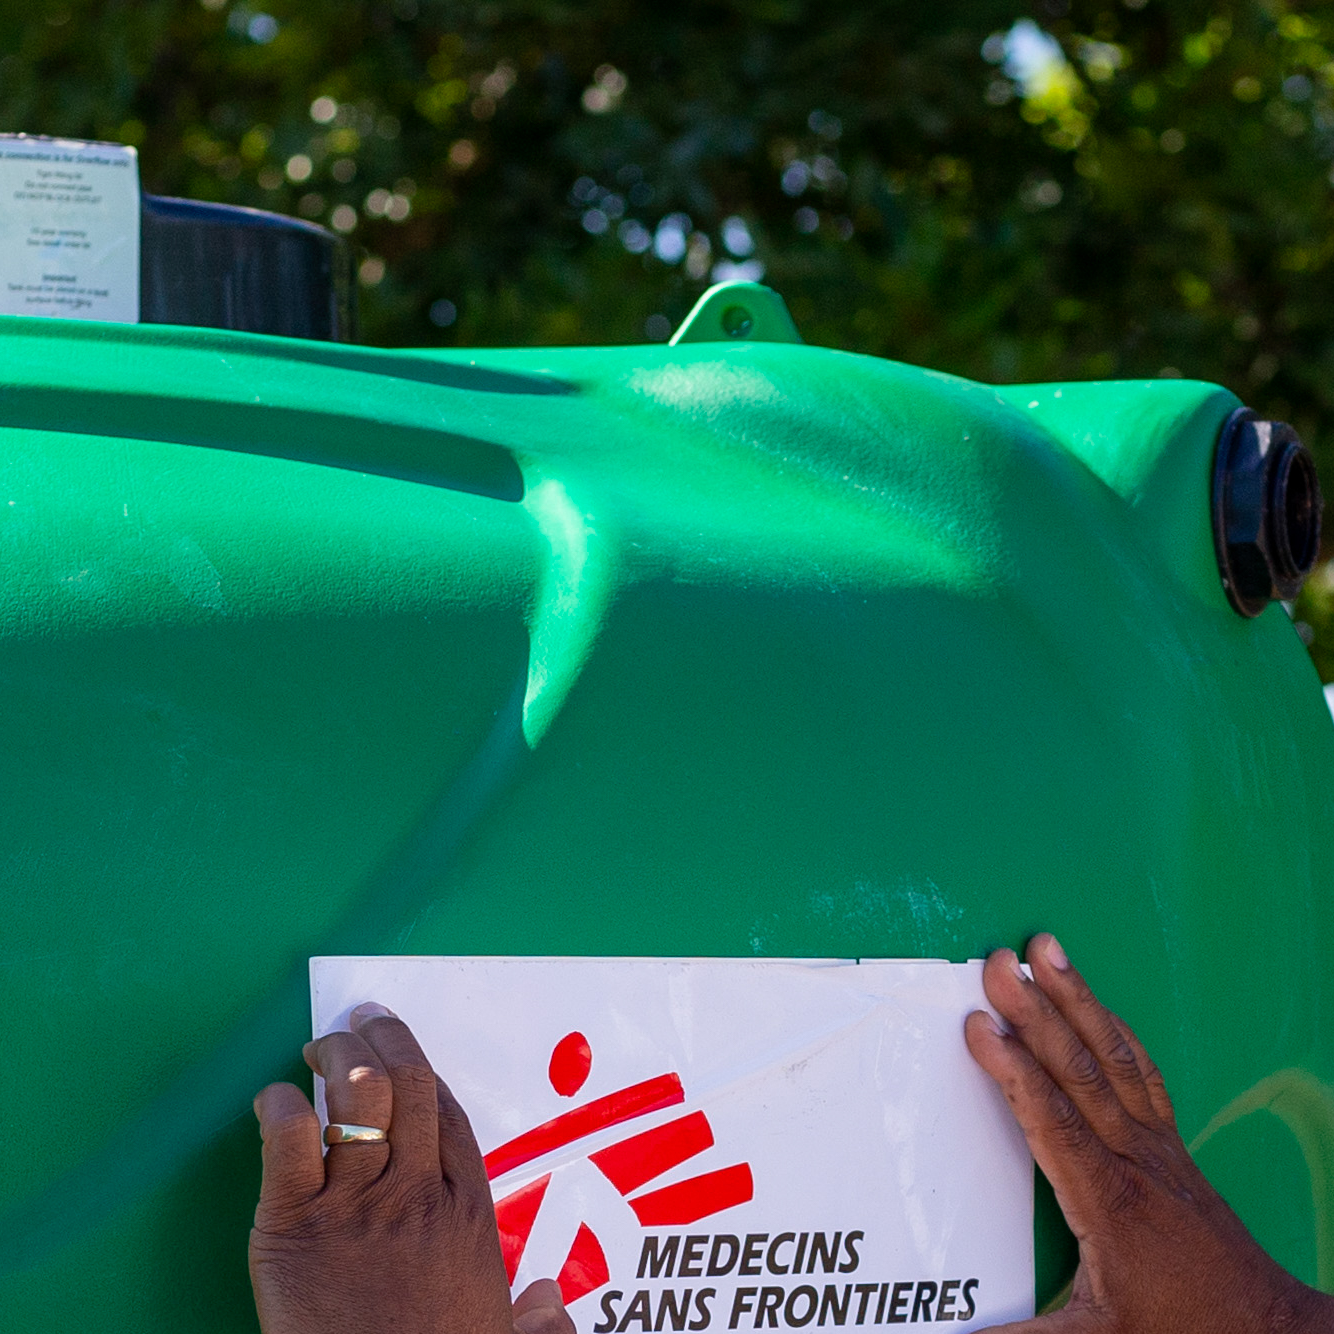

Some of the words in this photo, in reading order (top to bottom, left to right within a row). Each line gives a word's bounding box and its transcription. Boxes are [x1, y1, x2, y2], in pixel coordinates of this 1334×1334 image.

[636, 1230, 865, 1279] MEDECINS
[594, 1288, 716, 1334] SANS
[728, 1278, 980, 1330] FRONTIERES
